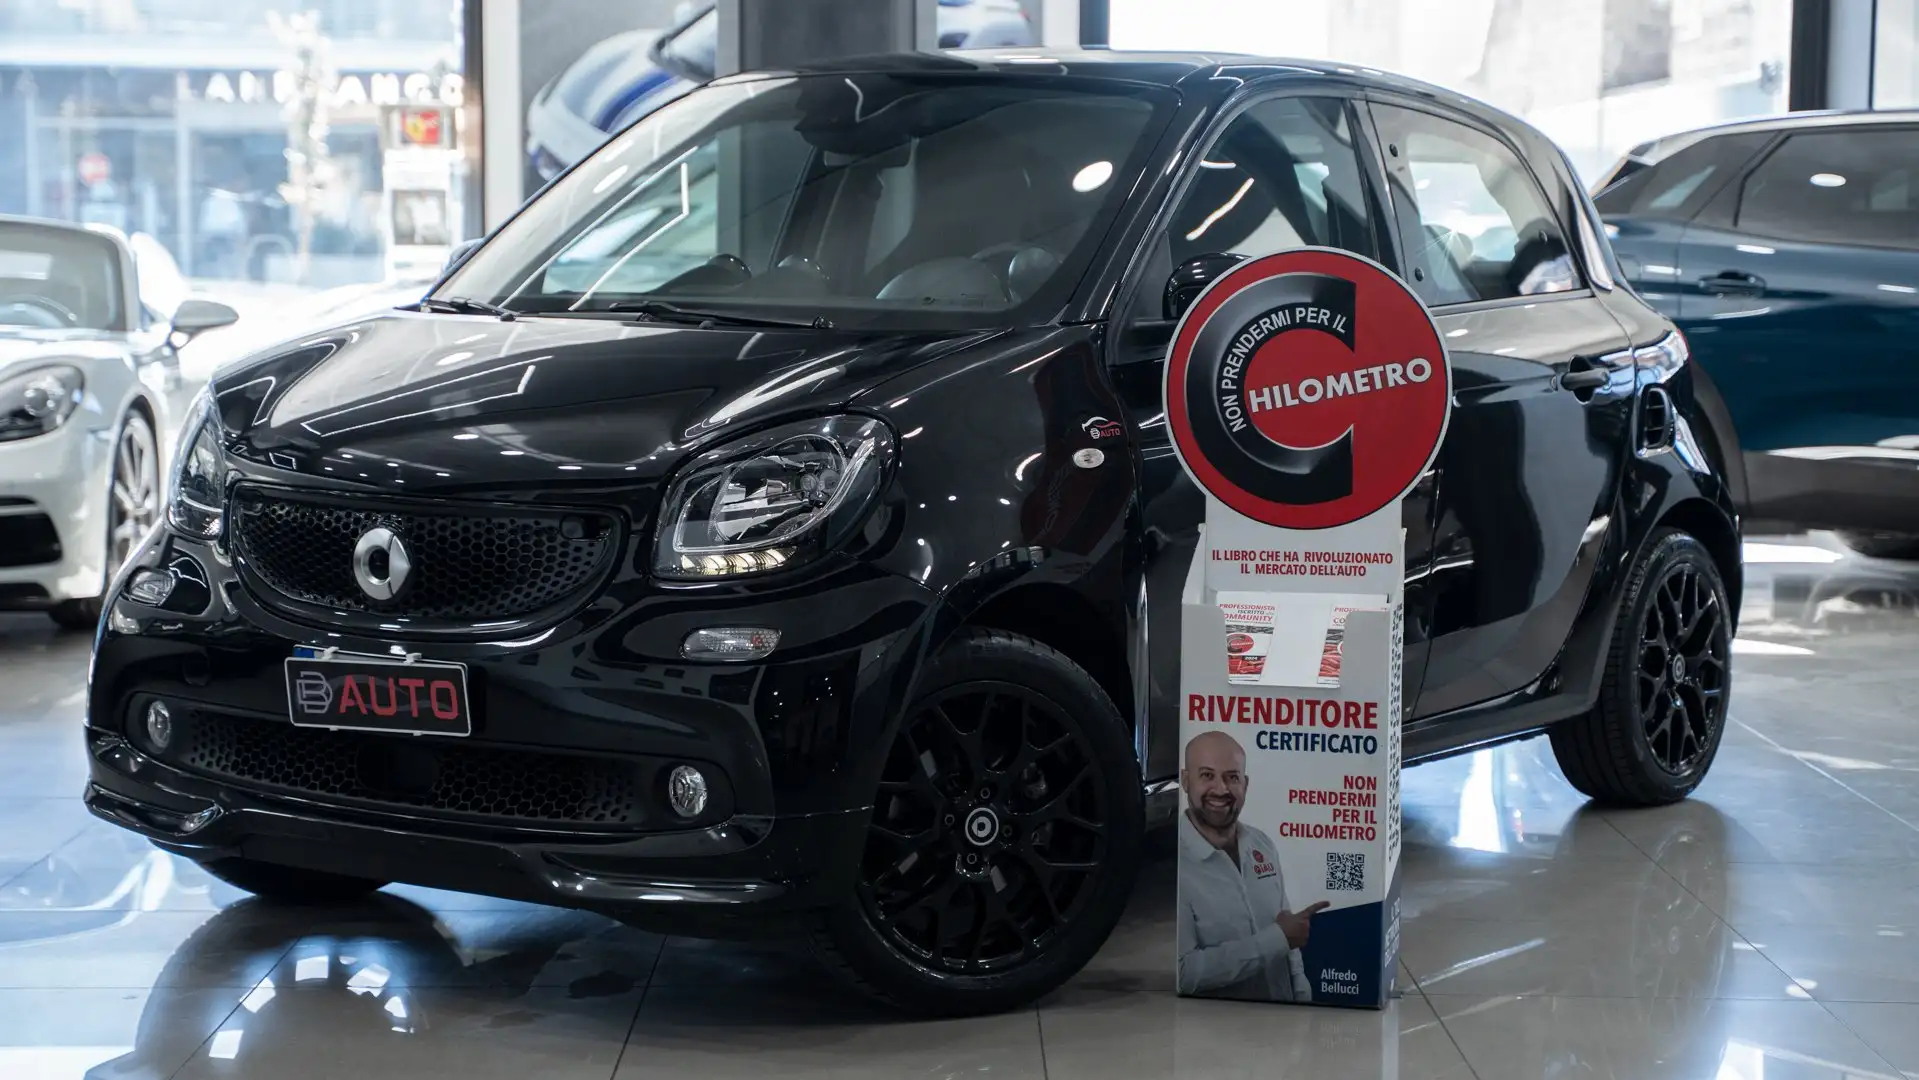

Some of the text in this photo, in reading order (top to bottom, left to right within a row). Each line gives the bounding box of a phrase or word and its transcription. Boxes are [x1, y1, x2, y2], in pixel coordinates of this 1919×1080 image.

[1221, 307, 1348, 432] NON PRENDERMI PER IL
[1100, 428, 1121, 437] AUTO
[1212, 550, 1393, 564] IL LIBRO CHE HA RIVOLUZIONATO
[1241, 564, 1250, 574] IL
[1255, 564, 1307, 576] MERCATO
[1224, 613, 1273, 622] OMMUNITY
[339, 674, 460, 720] AUTO
[1188, 694, 1378, 730] RIVENDITORE
[1256, 730, 1378, 755] CERTIFICATO
[1344, 775, 1377, 791] NON
[1289, 790, 1377, 807] PRENDERMI
[1332, 808, 1377, 825] PER IL
[1280, 822, 1376, 841] CHILOMETRO
[1321, 968, 1357, 982] Alfredo
[1321, 981, 1359, 995] Bellucci
